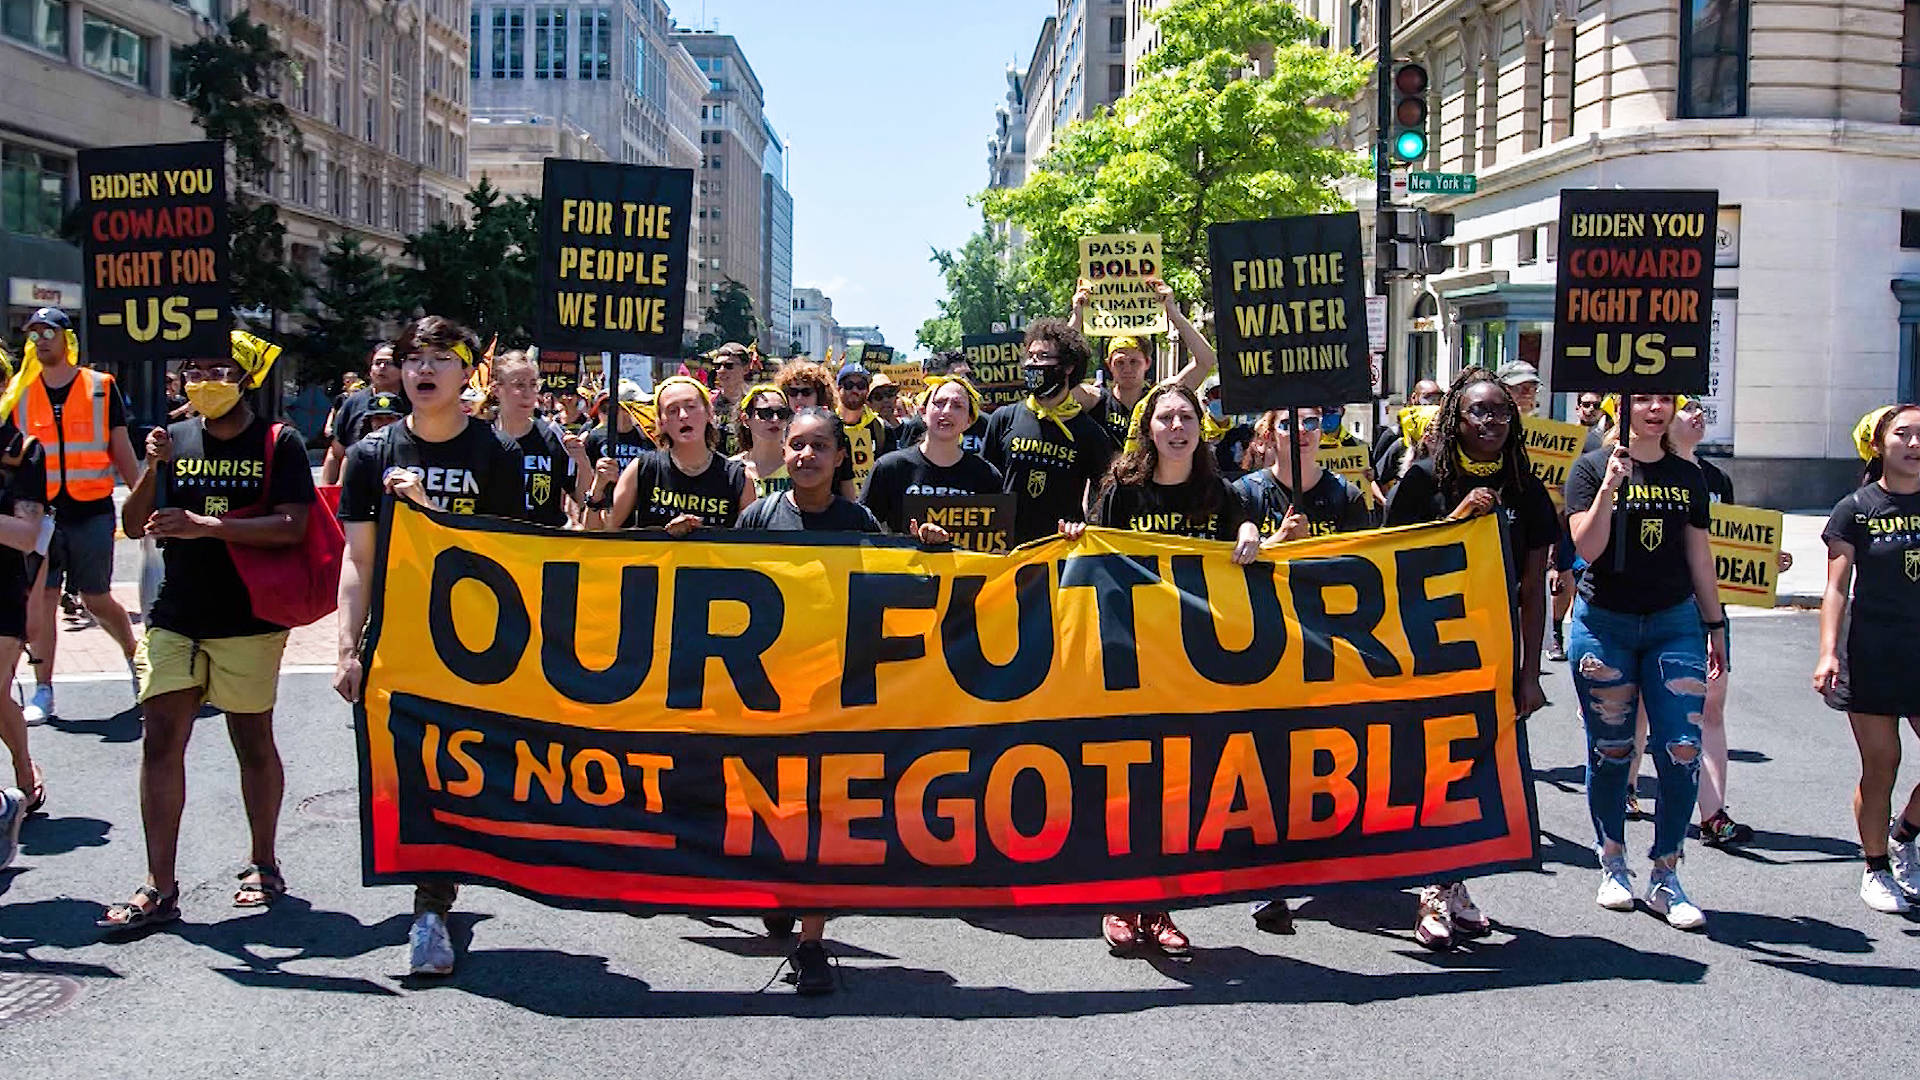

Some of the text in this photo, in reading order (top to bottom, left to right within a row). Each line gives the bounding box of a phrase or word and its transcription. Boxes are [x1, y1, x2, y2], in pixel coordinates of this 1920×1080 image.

[90, 169, 213, 200] BIDEN YOU
[1411, 175, 1431, 190] New
[1436, 175, 1459, 189] York
[92, 205, 215, 242] COWARD
[562, 199, 672, 239] FOR THE
[1571, 213, 1705, 237] BIDEN YOU
[1089, 241, 1154, 256] PASS A
[94, 248, 216, 289] FIGHT FOR
[559, 246, 669, 286] PEOPLE
[1089, 259, 1155, 279] BOLD
[1232, 252, 1345, 292] FOR THE
[1569, 248, 1702, 279] COWARD
[1090, 281, 1156, 295] CIVILIAN
[558, 291, 666, 334] WE LOVE
[1091, 297, 1157, 311] CLIMATE
[1235, 297, 1347, 339] WATER
[1567, 287, 1643, 323] FIGHT
[1649, 287, 1699, 323] FOR
[1092, 313, 1157, 329] CORPS
[967, 343, 1025, 363] BIDEN
[1238, 350, 1274, 377] WE
[1281, 344, 1350, 374] DRINK
[1011, 437, 1078, 463] SUNRISE
[1521, 429, 1578, 452] LIMATE
[176, 459, 264, 478] SUNRISE
[1530, 462, 1566, 486] EAL
[650, 487, 730, 515] SUNRISE
[927, 507, 996, 527] MEET
[977, 530, 1007, 552] US
[1715, 555, 1770, 587] DEAL
[429, 541, 1482, 714] OUR FUTURE
[421, 713, 1483, 867] IS NOT NEGOTIABLE
